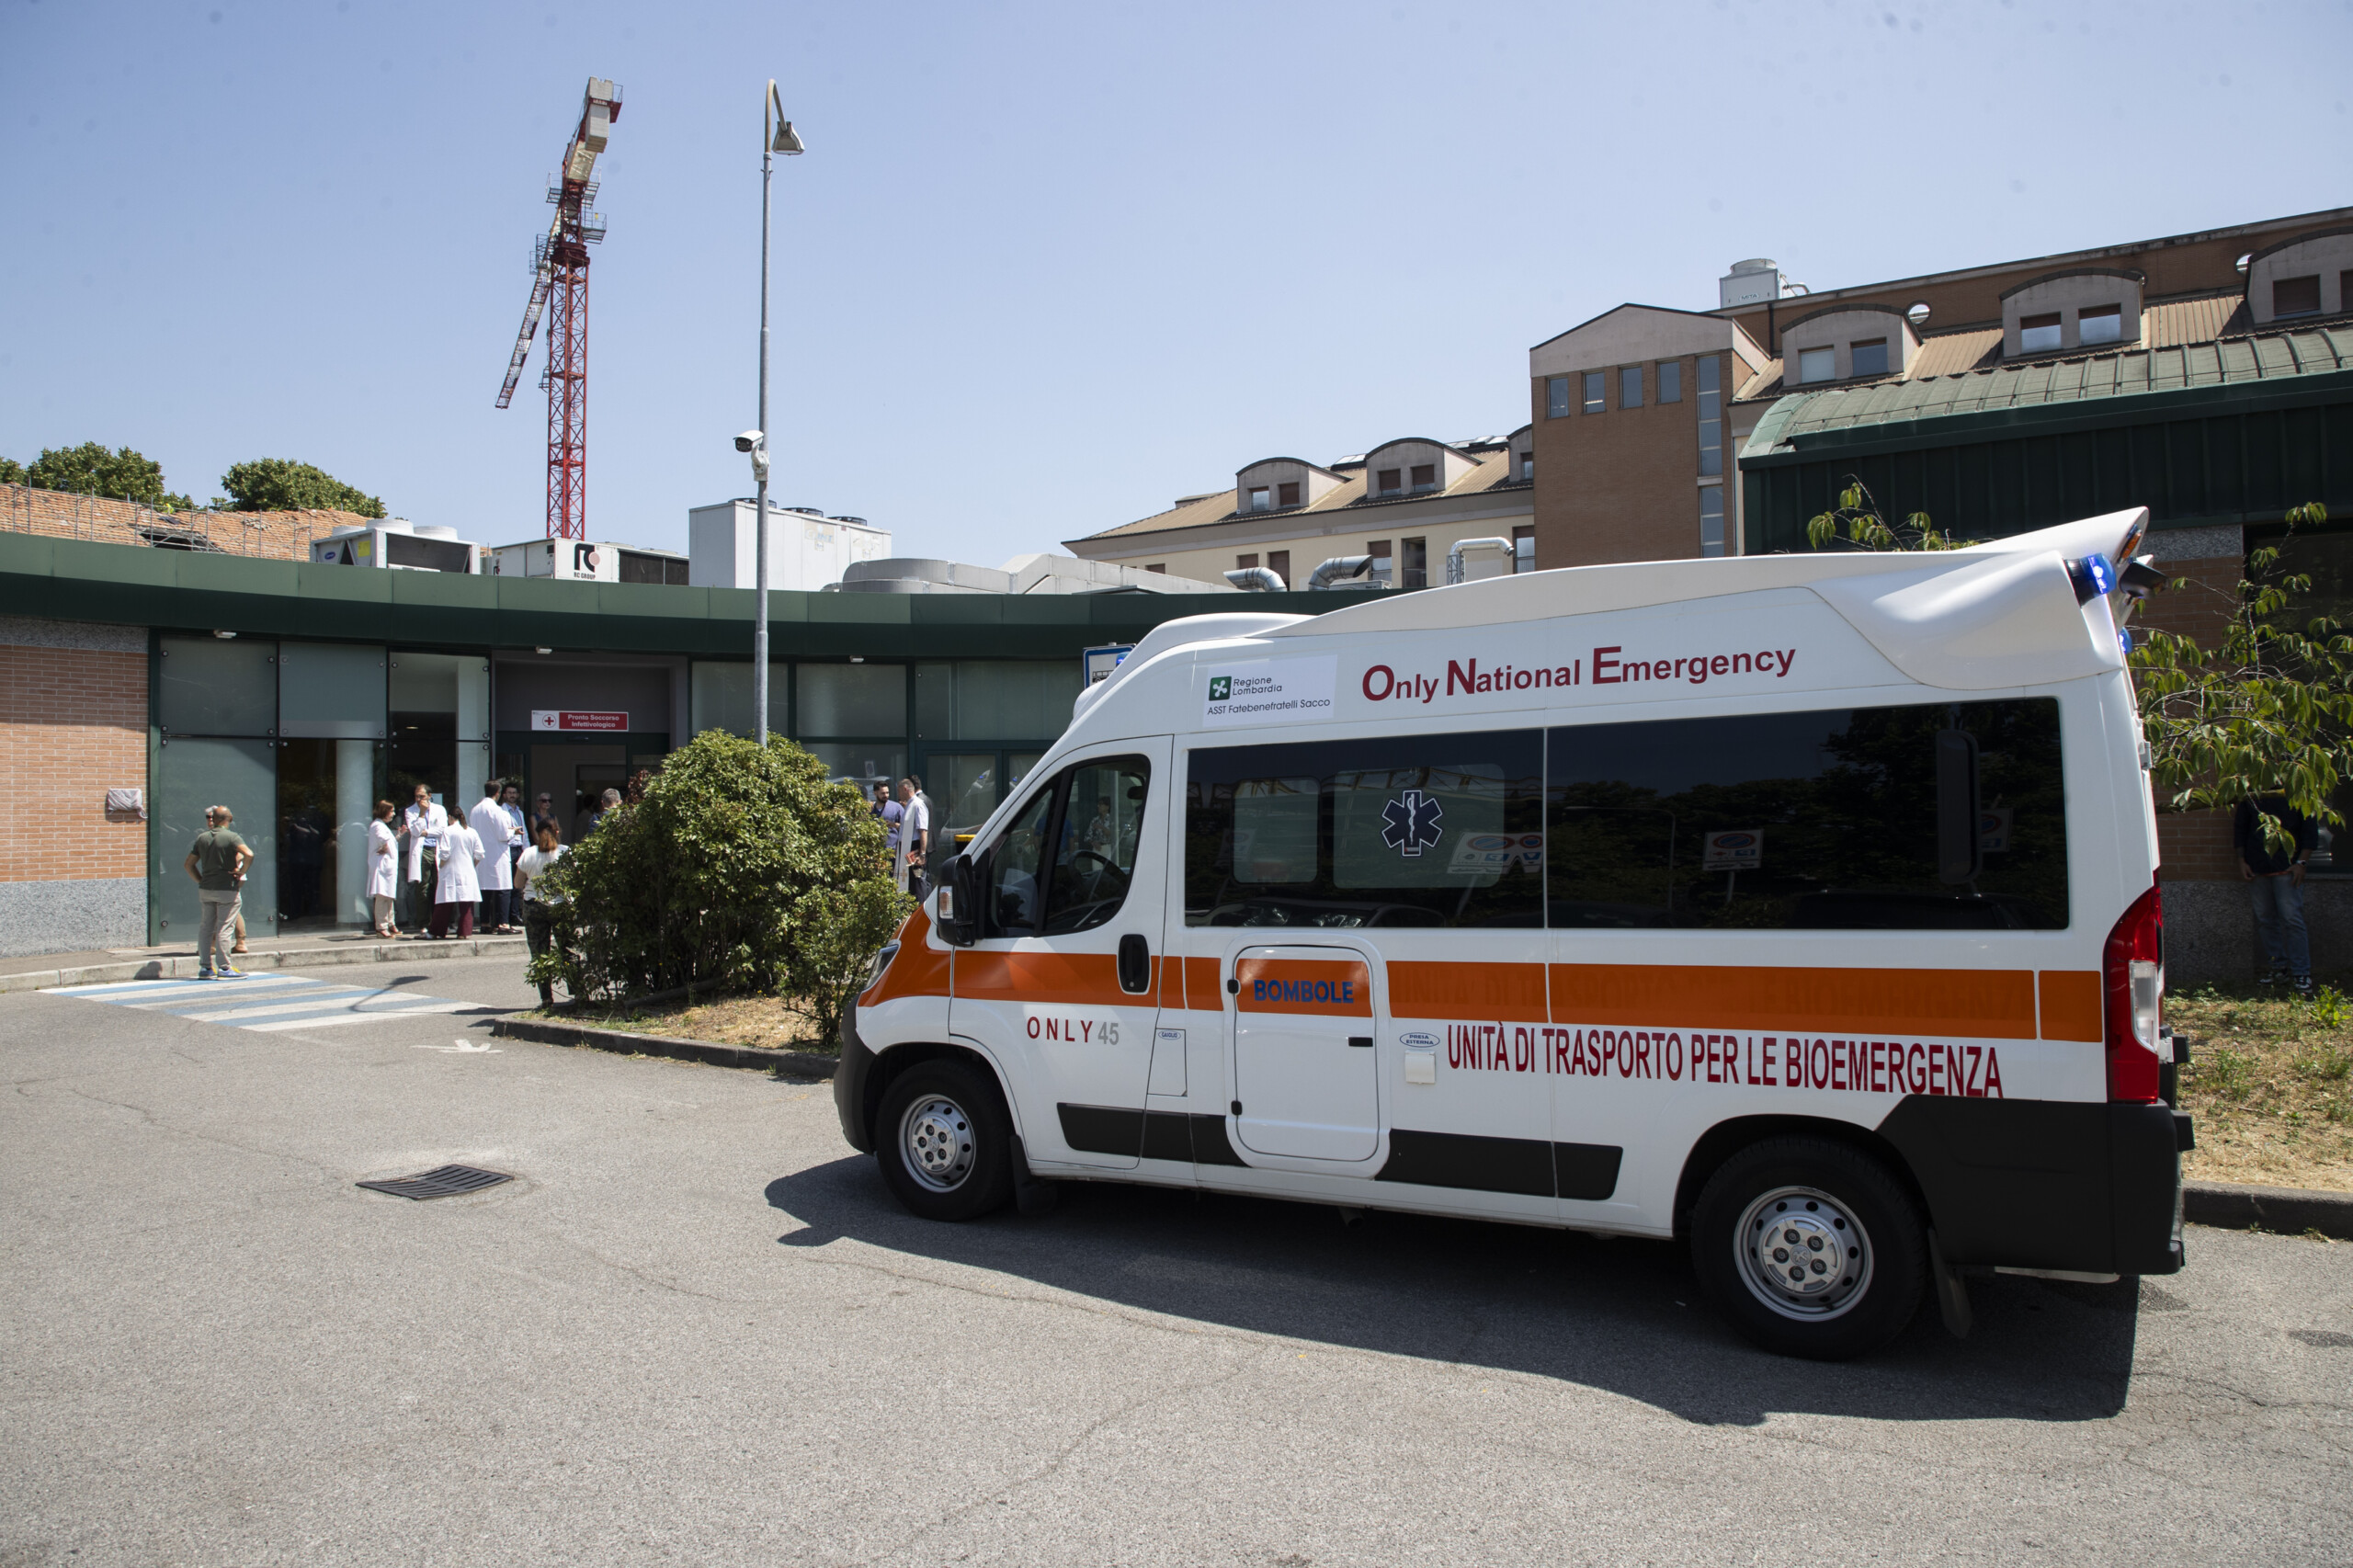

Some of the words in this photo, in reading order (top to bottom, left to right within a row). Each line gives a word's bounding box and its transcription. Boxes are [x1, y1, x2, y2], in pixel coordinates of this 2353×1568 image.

[1233, 676, 1272, 687] Regione
[1361, 664, 1439, 704] Only
[1446, 657, 1581, 697] National
[1592, 645, 1797, 685] Emergency
[1232, 684, 1282, 696] Lombardia
[1207, 705, 1226, 715] ASST
[1228, 699, 1298, 713] Fatebenefratelli
[1300, 699, 1331, 708] Sacco
[1254, 979, 1354, 1004] BOMBOLE
[1027, 1016, 1093, 1043] ONLY
[1097, 1021, 1120, 1046] 45
[1448, 1020, 1510, 1072] UNITÀ
[1516, 1027, 1536, 1073] DI
[1541, 1028, 1684, 1081] TRASPORTO
[1691, 1034, 1740, 1085] PER
[1747, 1036, 1778, 1086] LE
[1786, 1038, 2004, 1099] BIOEMERGENZA
